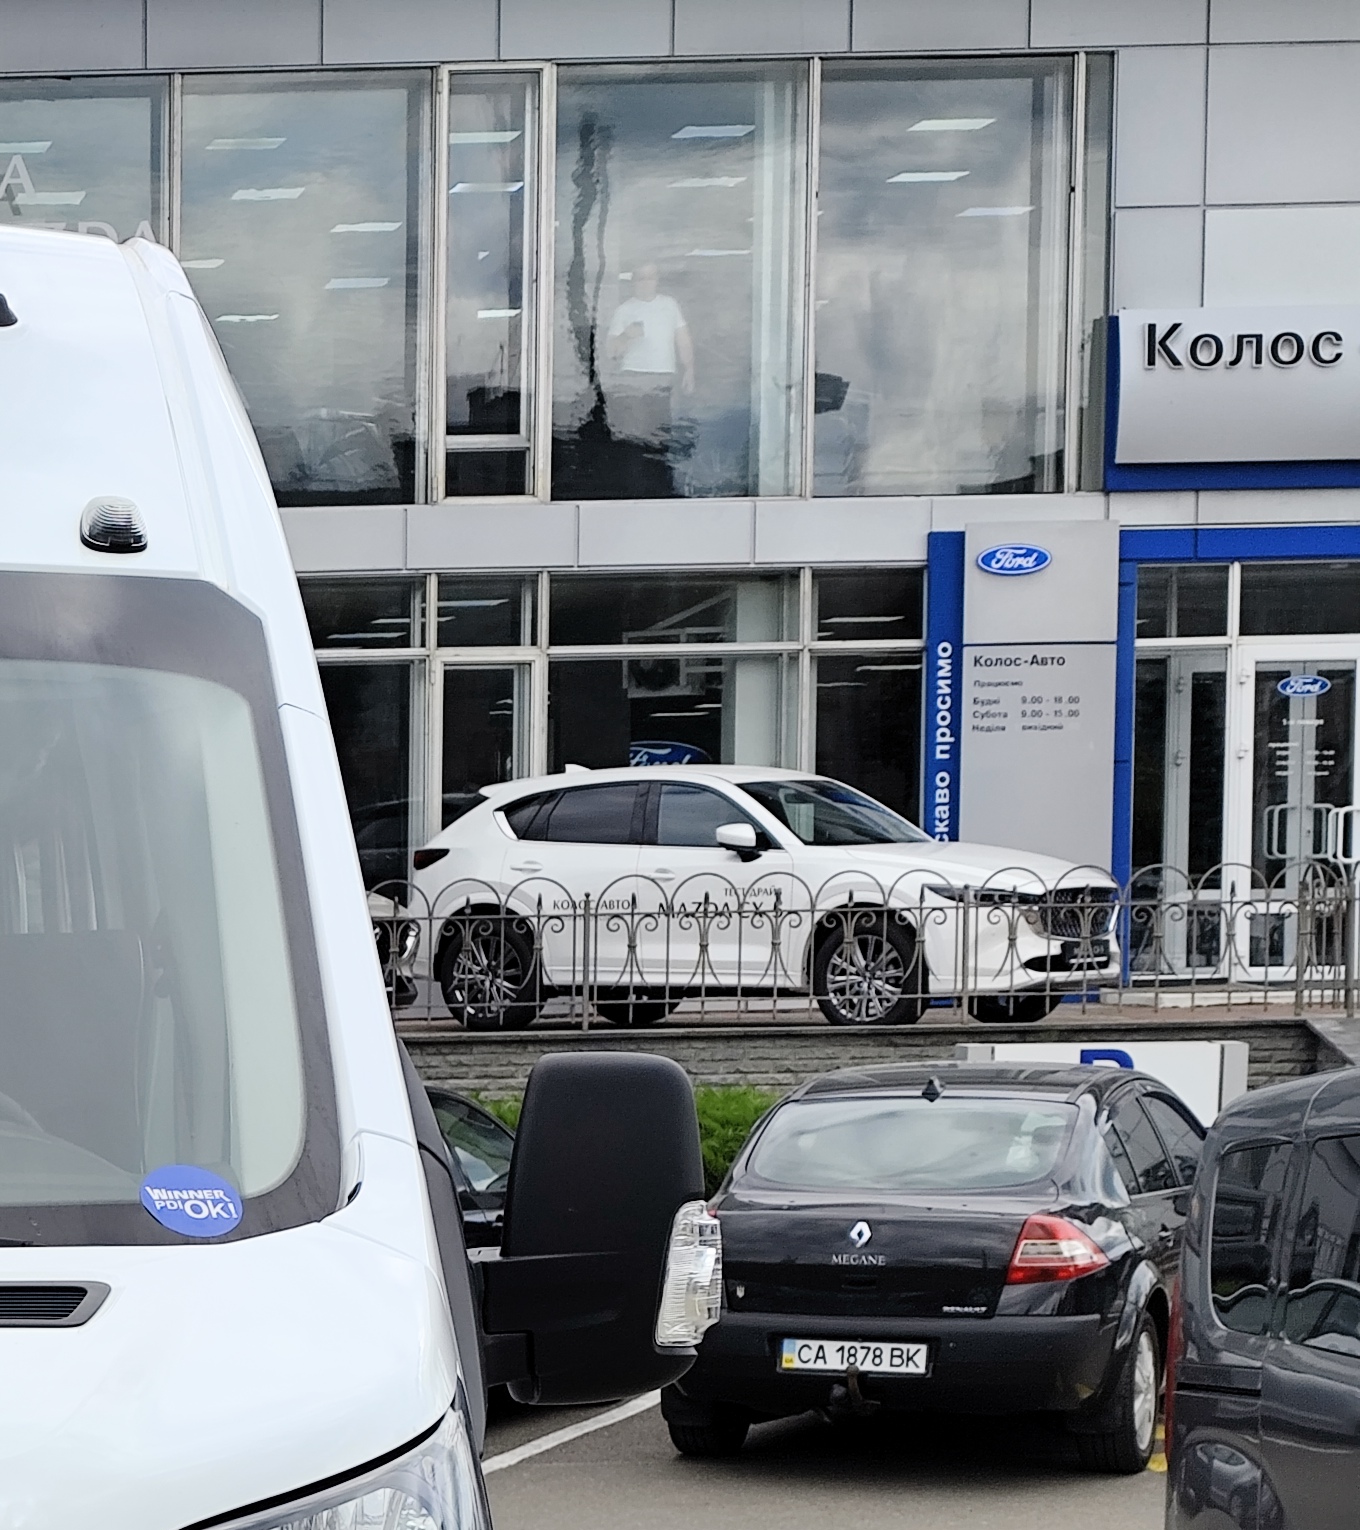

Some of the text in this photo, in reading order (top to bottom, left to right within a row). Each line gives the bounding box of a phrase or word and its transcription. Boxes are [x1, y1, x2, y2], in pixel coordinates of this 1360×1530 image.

[1145, 321, 1344, 369] Колос
[991, 547, 1041, 569] Ford
[973, 654, 1066, 668] Колос-Авто
[1285, 678, 1322, 693] Ford
[935, 641, 955, 760] просимо
[972, 709, 1009, 721] Субота
[144, 1186, 232, 1202] WINNER
[153, 1199, 239, 1219] PDI OK!
[830, 1253, 887, 1266] MEGANE
[797, 1343, 922, 1369] CA 1878 BK
